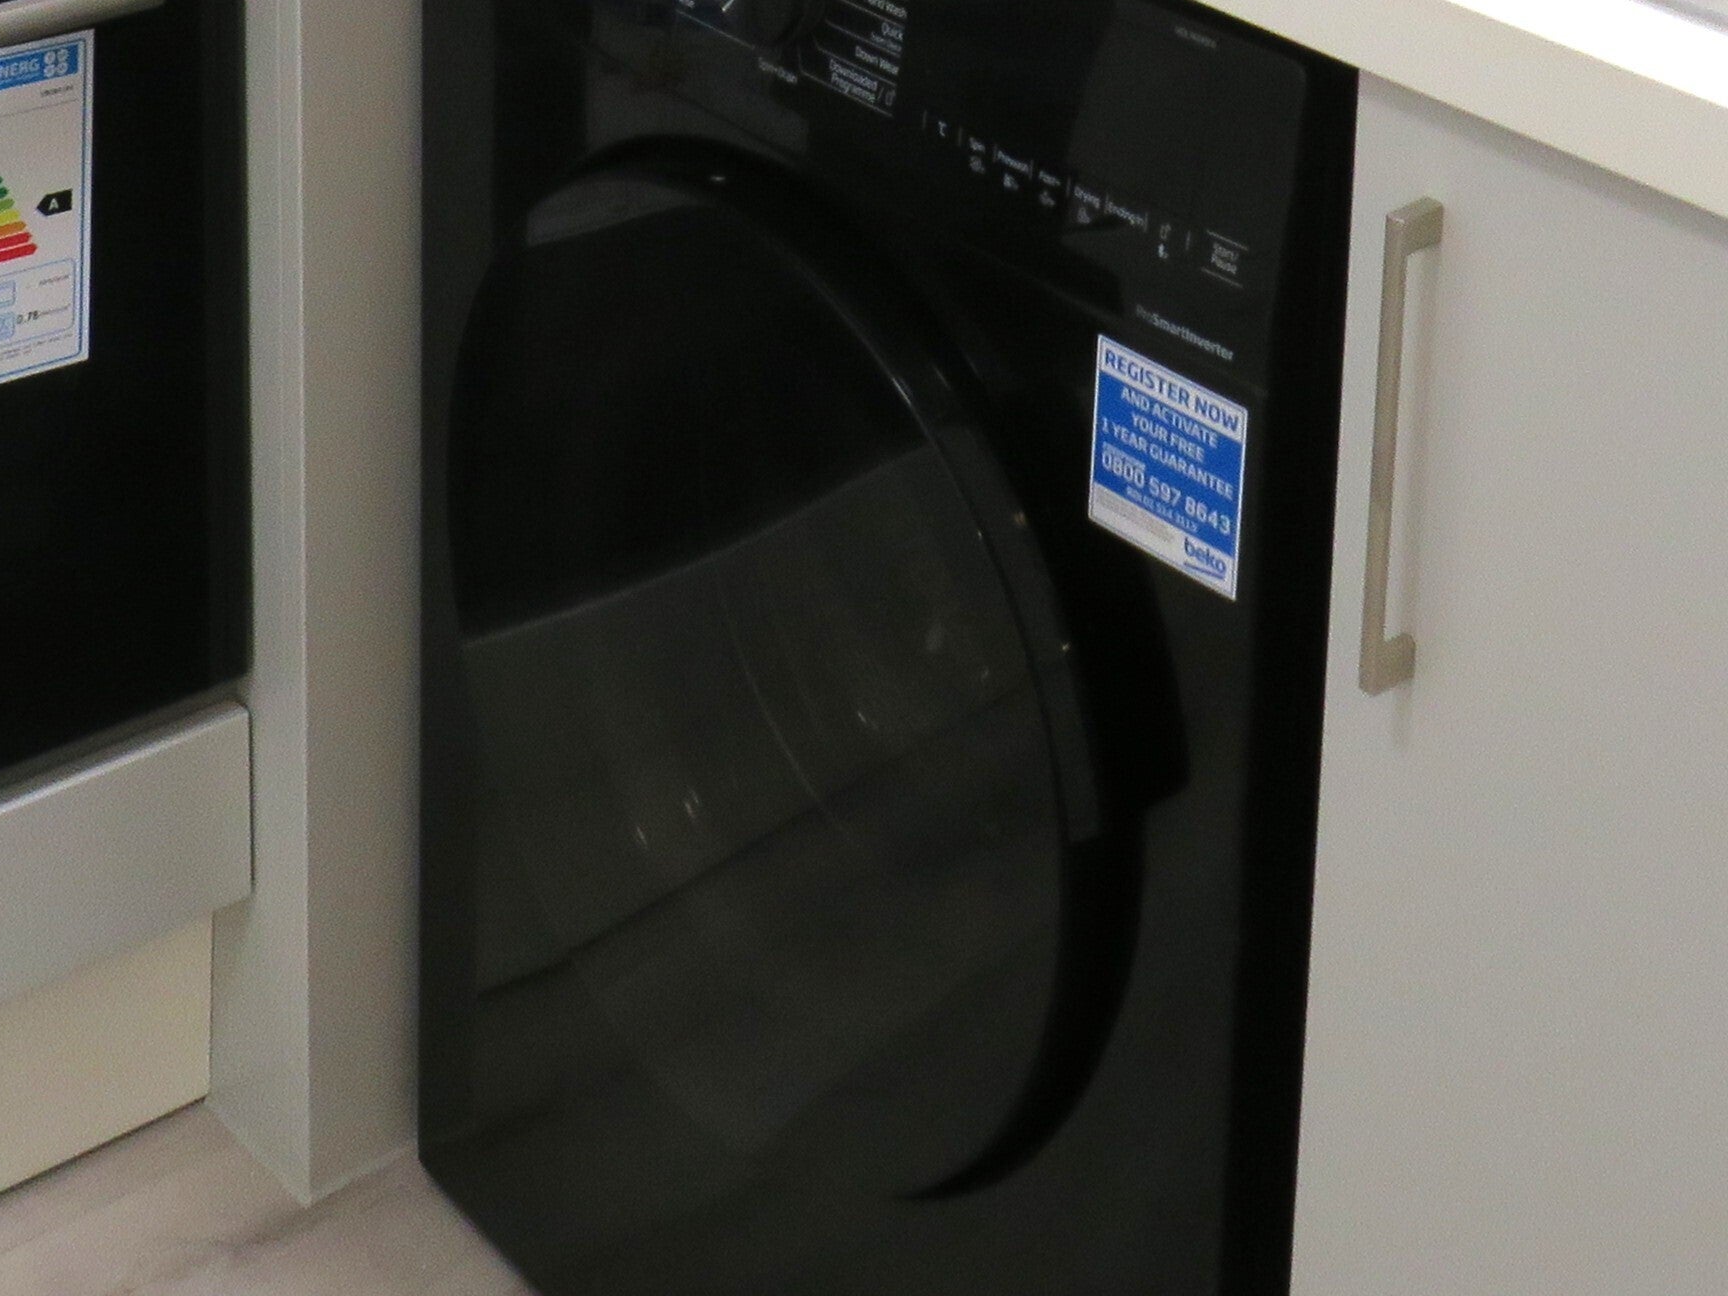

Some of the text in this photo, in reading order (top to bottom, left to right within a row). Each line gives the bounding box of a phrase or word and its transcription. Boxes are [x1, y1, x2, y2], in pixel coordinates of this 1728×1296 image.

[881, 21, 904, 42] Quick
[829, 58, 878, 92] Downloaded
[48, 197, 60, 211] A
[1105, 349, 1239, 432] REGISTER NOW
[1121, 386, 1219, 448] AND ACTIVATE
[1132, 414, 1168, 442] YOUR
[1170, 431, 1205, 463] FREE
[1102, 417, 1109, 434] 1
[1114, 424, 1147, 453] YEAR
[1149, 443, 1234, 500] GUARANTEE
[1102, 451, 1145, 488] 0800
[1149, 477, 1181, 507] 597
[1184, 496, 1231, 536] 8643
[1184, 536, 1227, 574] beko
